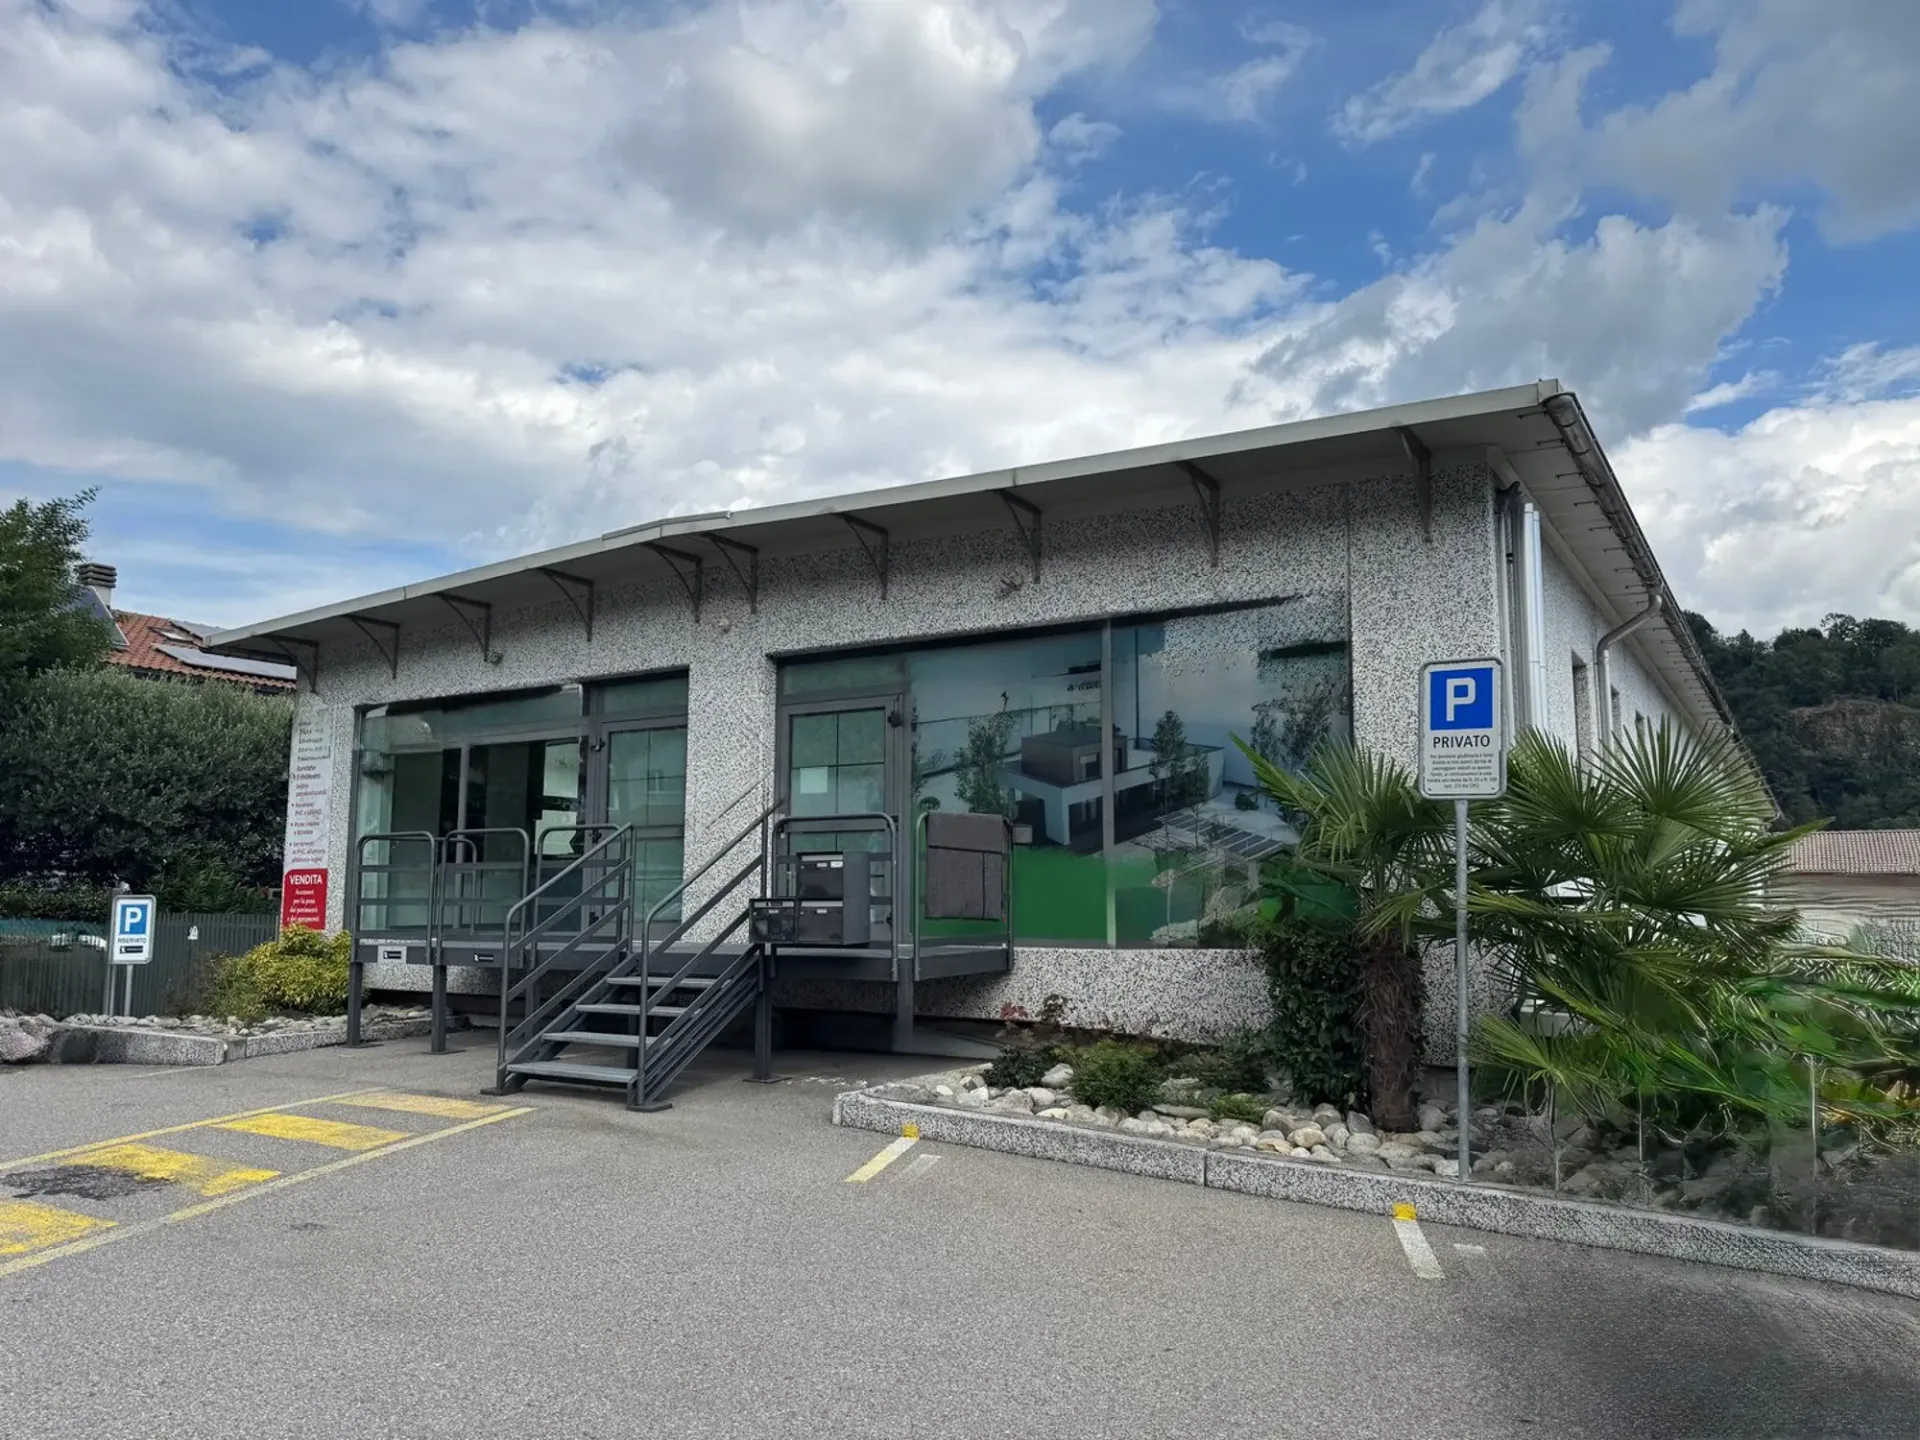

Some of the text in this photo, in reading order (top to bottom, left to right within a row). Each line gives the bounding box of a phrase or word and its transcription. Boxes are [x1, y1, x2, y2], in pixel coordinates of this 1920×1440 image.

[1446, 677, 1476, 722] P
[1433, 734, 1490, 748] PRIVATO
[289, 874, 323, 885] VENDITA
[124, 907, 142, 932] P
